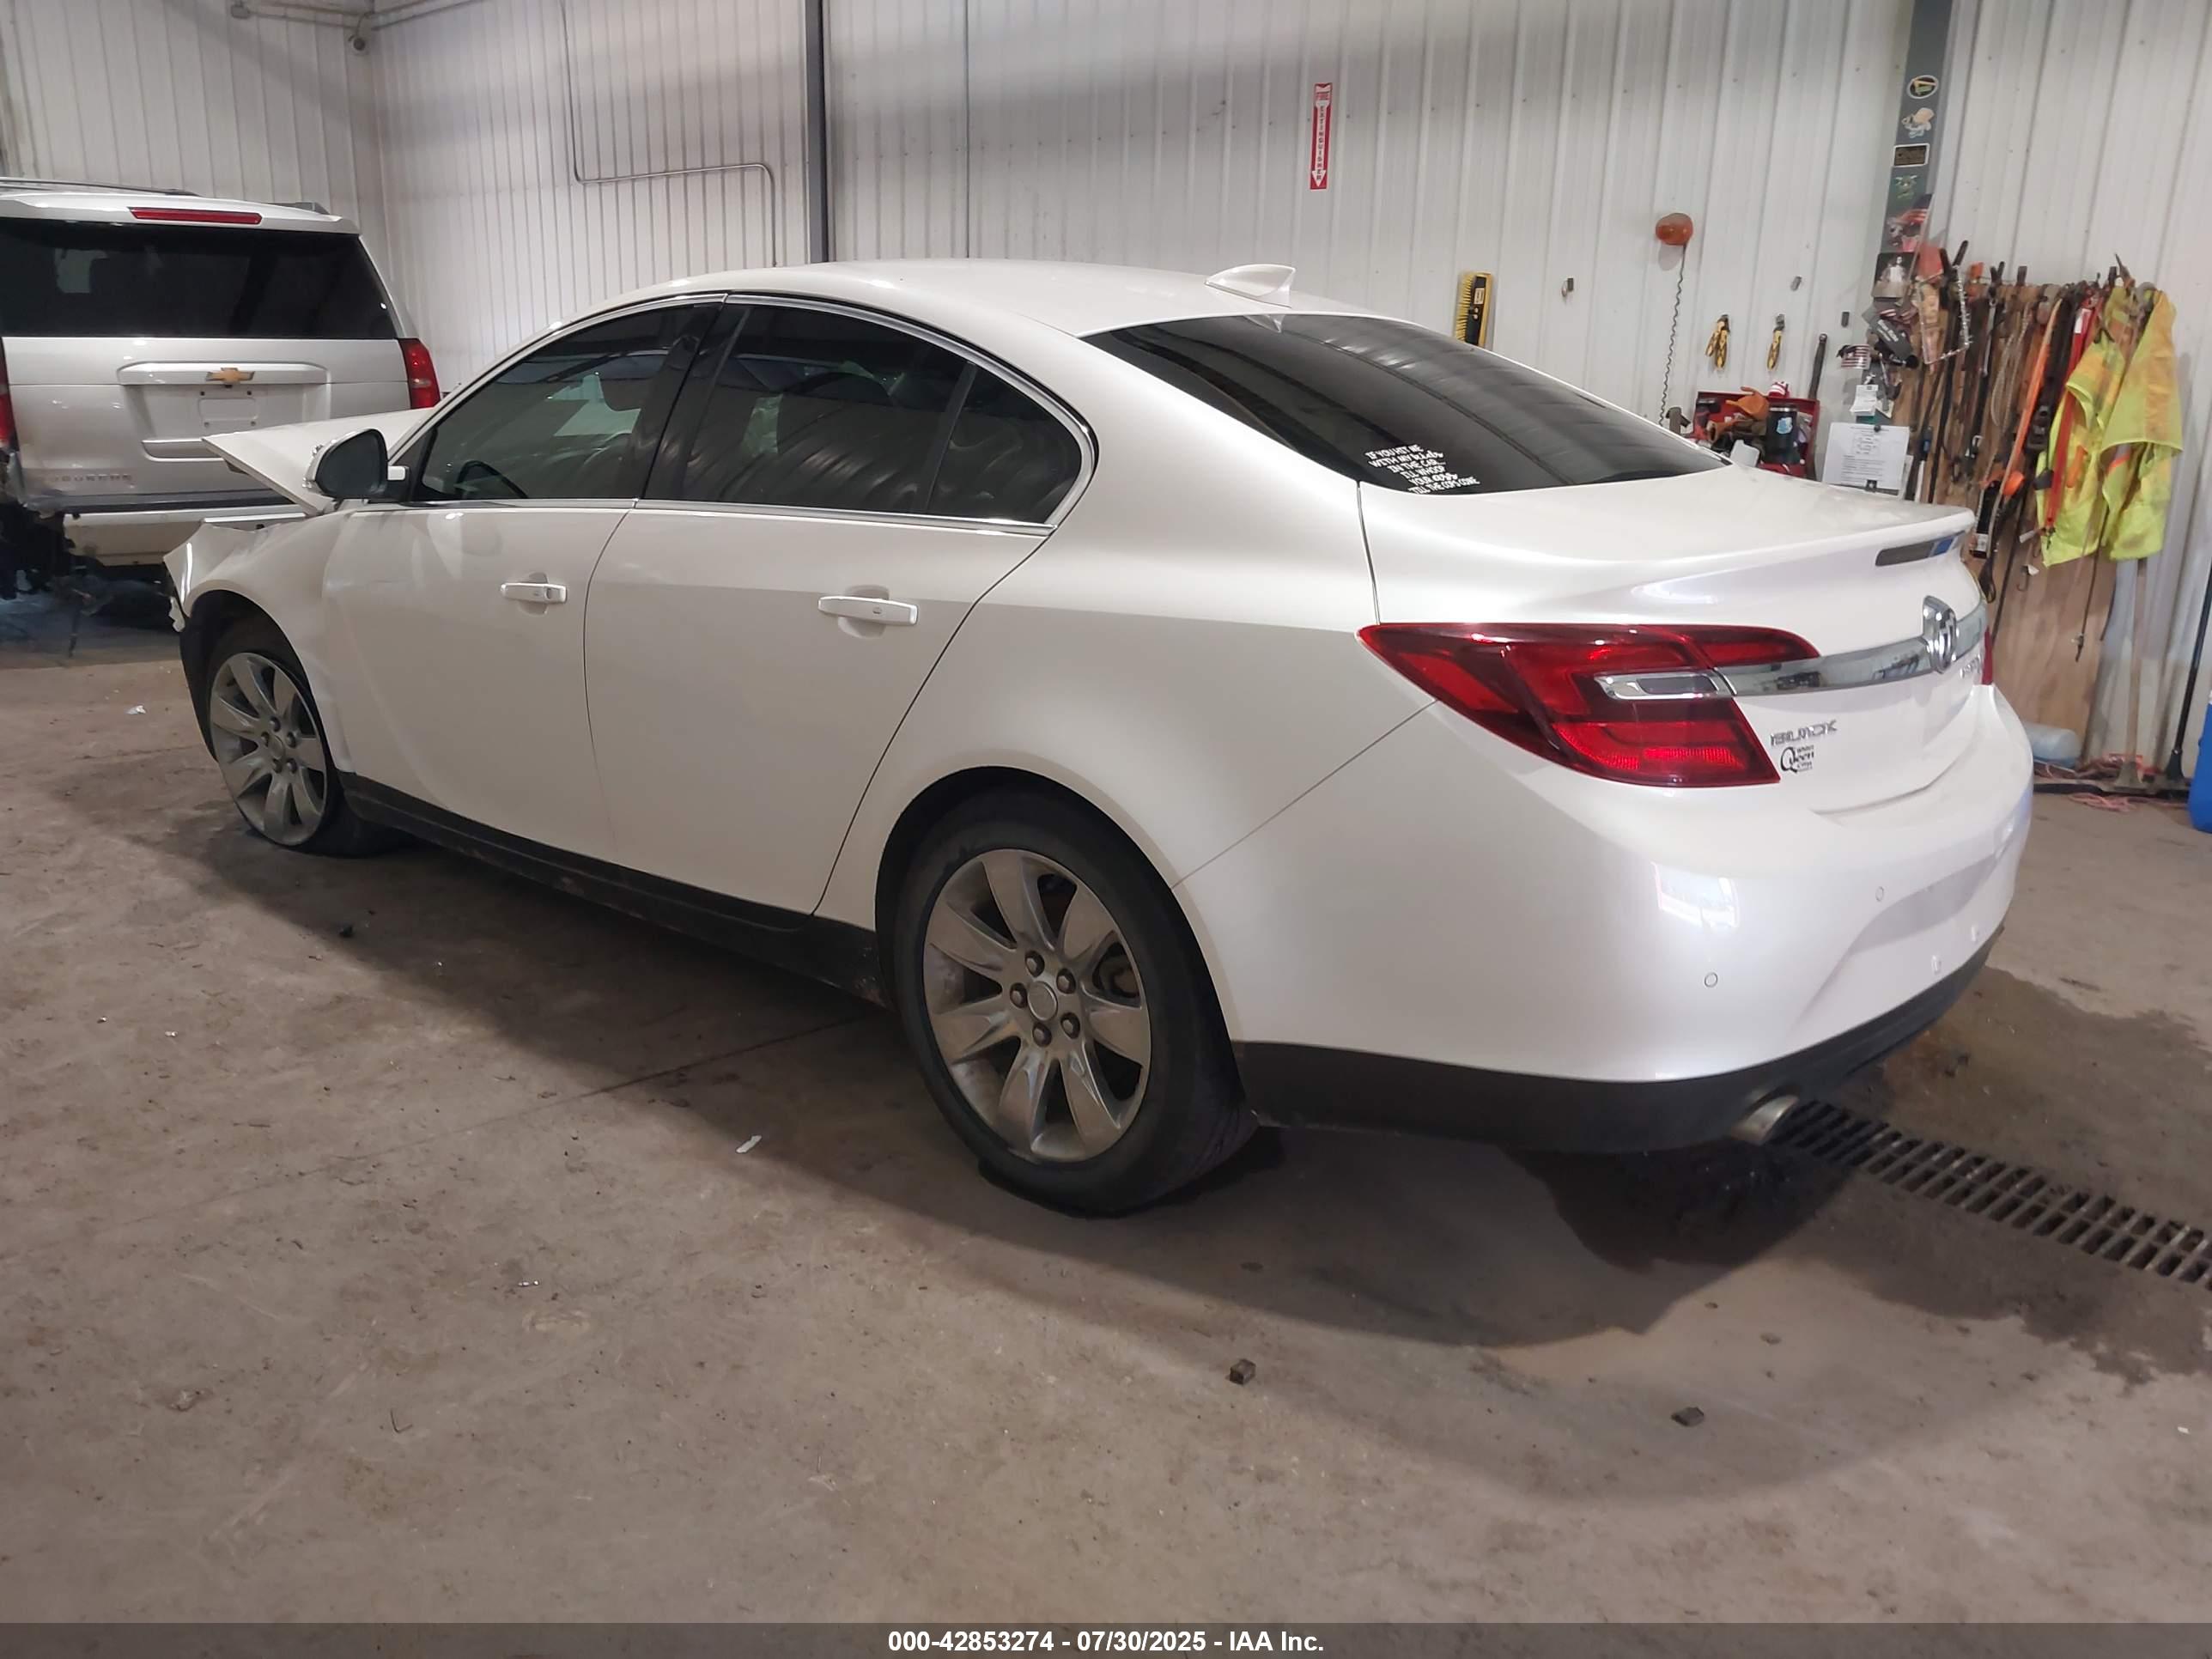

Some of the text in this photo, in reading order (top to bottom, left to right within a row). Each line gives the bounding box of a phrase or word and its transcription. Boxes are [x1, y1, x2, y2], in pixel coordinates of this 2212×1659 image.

[1365, 444, 1424, 459] IF YOU HIT ME
[1368, 457, 1400, 468] WITH
[1397, 454, 1413, 463] MY
[1387, 465, 1404, 473] IN
[1400, 460, 1423, 470] THE
[1415, 465, 1445, 476] WHOOP
[1408, 477, 1434, 486] YOUR
[1425, 482, 1445, 491] THE
[1441, 479, 1462, 489] COPS
[1458, 477, 1480, 486] COME
